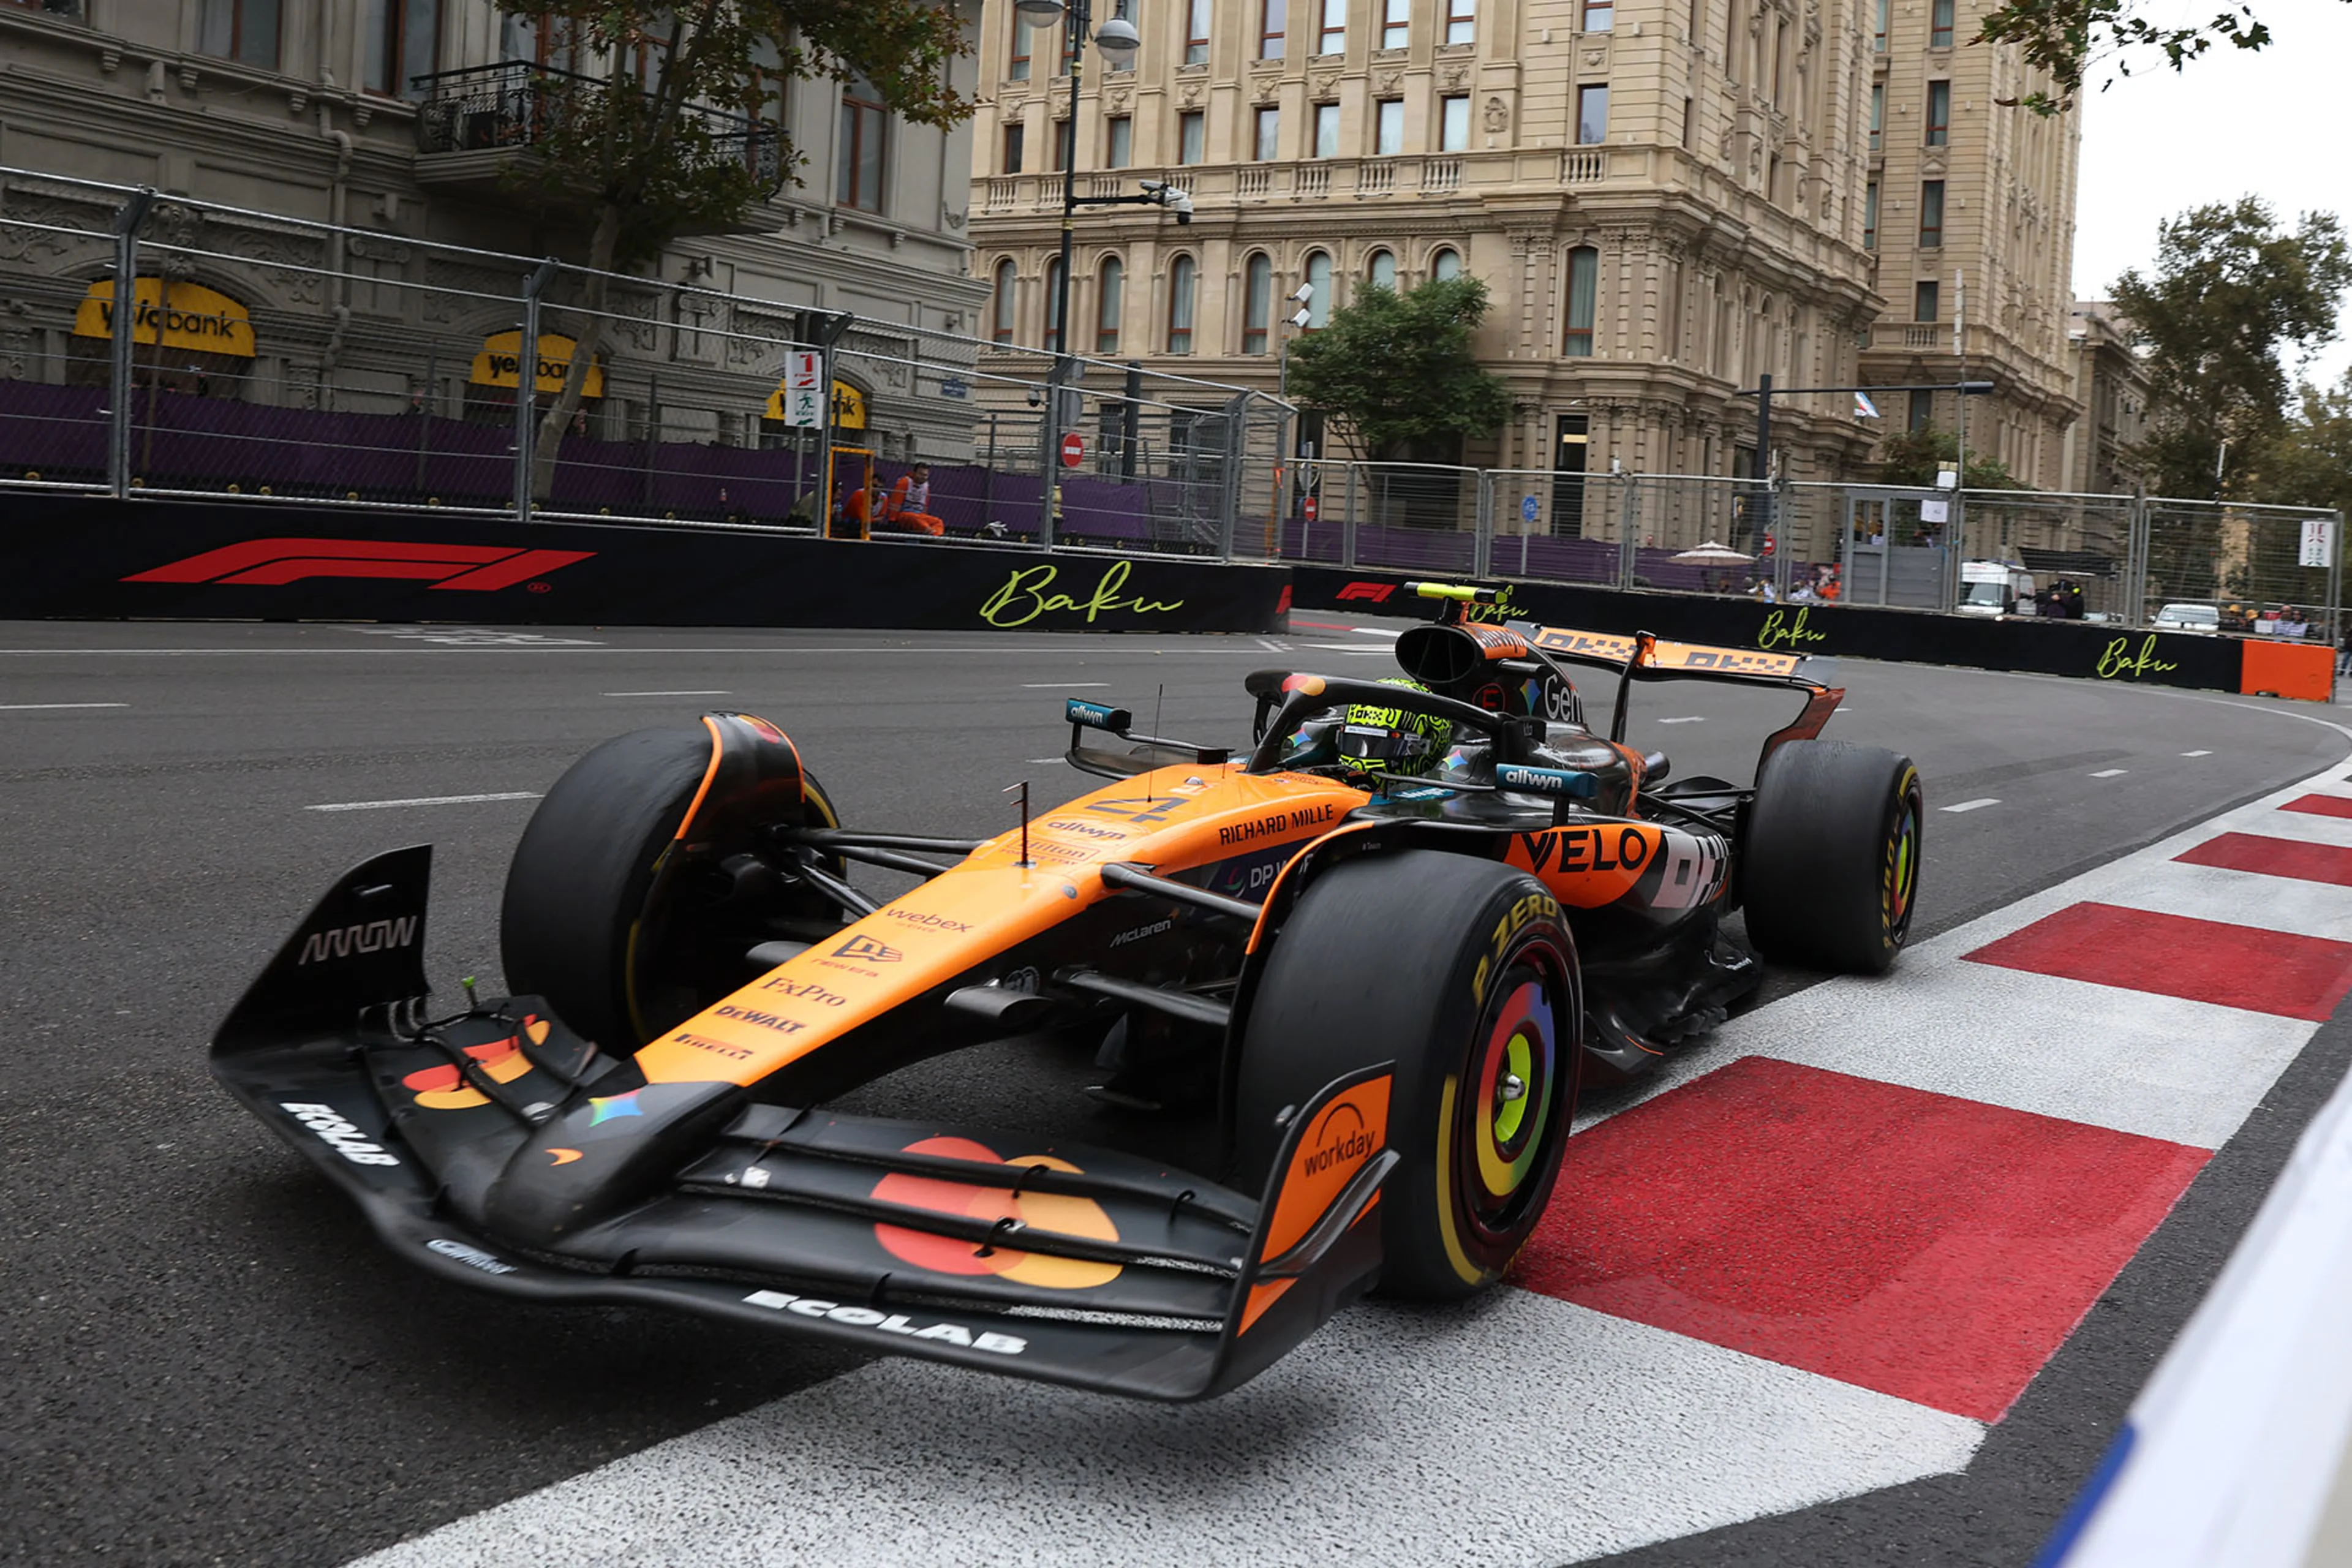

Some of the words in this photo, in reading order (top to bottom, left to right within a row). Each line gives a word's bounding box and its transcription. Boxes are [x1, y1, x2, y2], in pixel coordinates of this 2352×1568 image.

[100, 298, 234, 339] ylobank
[118, 538, 598, 592] F1
[979, 560, 1185, 628] Baku
[1335, 581, 1398, 603] F1
[1757, 606, 1827, 649] Baku
[2096, 634, 2179, 678] Baku
[1071, 705, 1103, 725] allwyn
[1505, 769, 1563, 789] allwyn
[1047, 821, 1127, 840] allwyn
[1219, 815, 1286, 846] RICHARD
[1291, 804, 1333, 829] MILLE
[1521, 827, 1647, 874] VELO
[1250, 864, 1274, 889] DP
[298, 916, 417, 965] ARROW
[887, 908, 976, 933] webex
[1109, 919, 1171, 948] McLaren
[1472, 953, 1490, 1009] P
[1490, 893, 1558, 962] ZERO
[758, 977, 846, 1007] FxPro
[673, 1033, 755, 1060] PIRELLI
[279, 1102, 401, 1166] ECOLAB
[1304, 1129, 1376, 1177] workday
[742, 1289, 1029, 1355] ECOLAB
